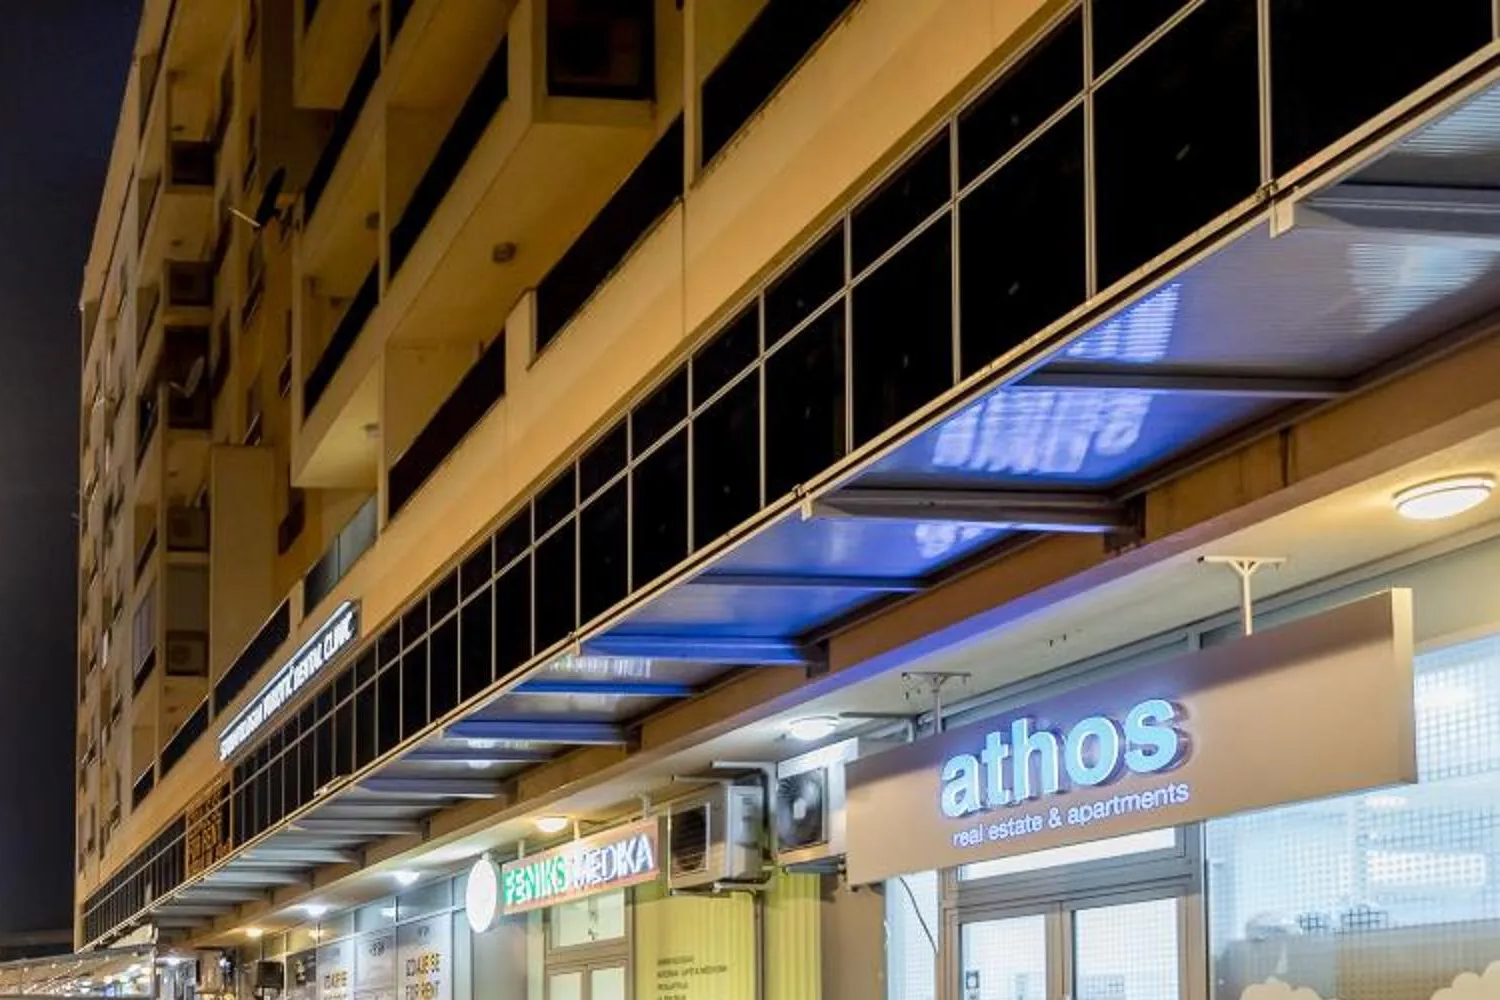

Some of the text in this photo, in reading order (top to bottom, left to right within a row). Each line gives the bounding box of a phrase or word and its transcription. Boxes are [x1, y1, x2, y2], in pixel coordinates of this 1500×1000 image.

[941, 699, 1180, 818] athos
[953, 783, 1190, 848] real estate & apartments
[503, 832, 654, 905] FENIKS MEDIKA
